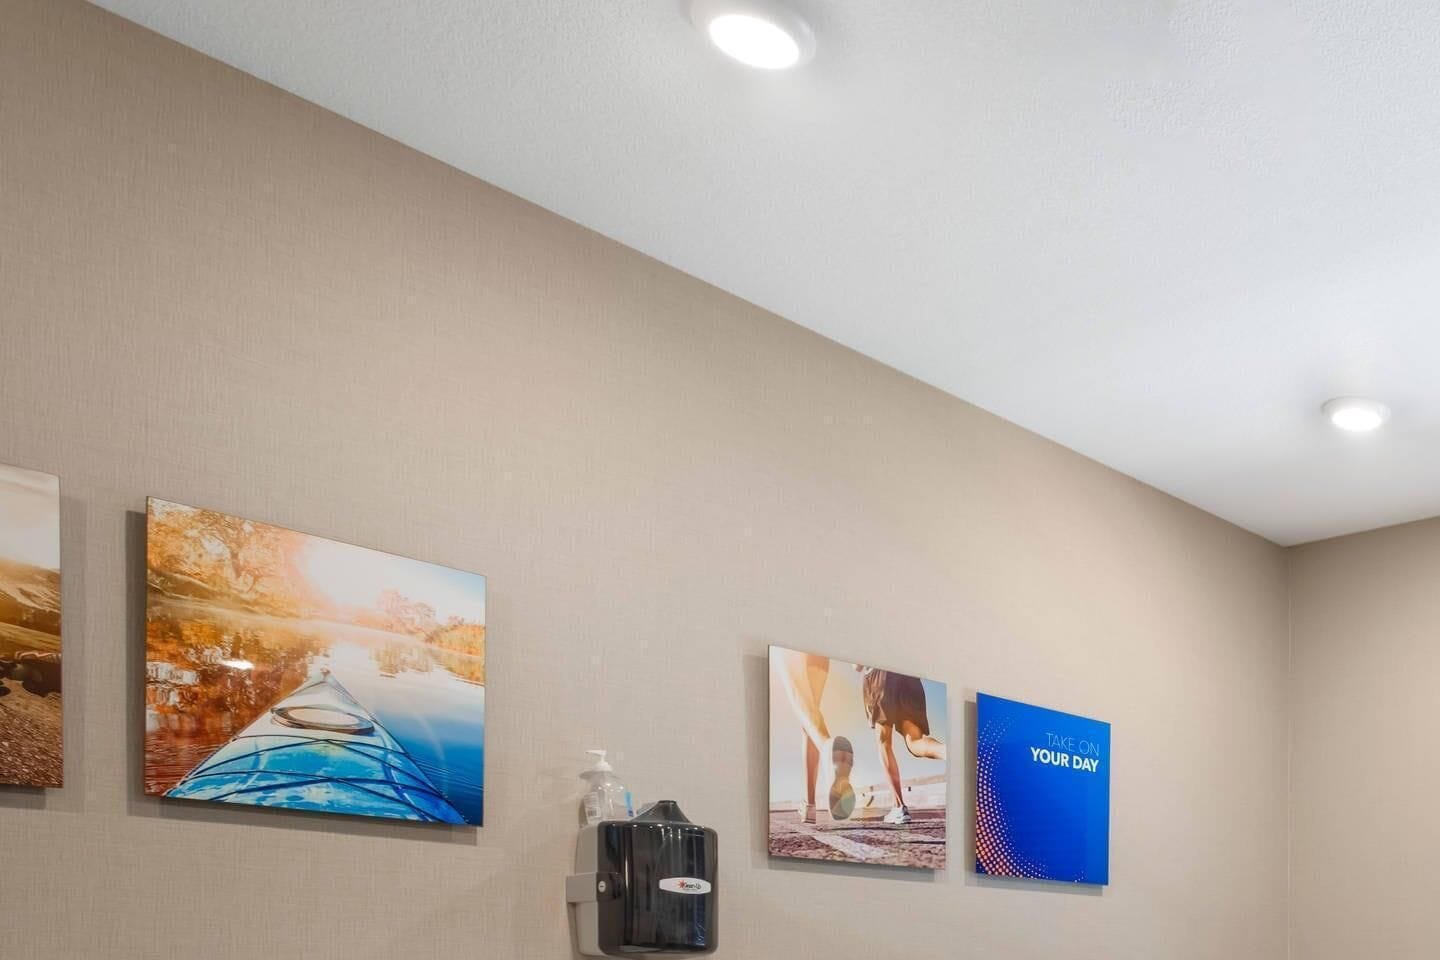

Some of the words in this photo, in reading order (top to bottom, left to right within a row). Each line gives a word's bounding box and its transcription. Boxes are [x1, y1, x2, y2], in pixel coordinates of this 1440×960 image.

[1045, 732, 1075, 752] TAKE
[1079, 740, 1099, 757] ON
[1030, 746, 1070, 768] YOUR
[1072, 755, 1099, 773] DAY
